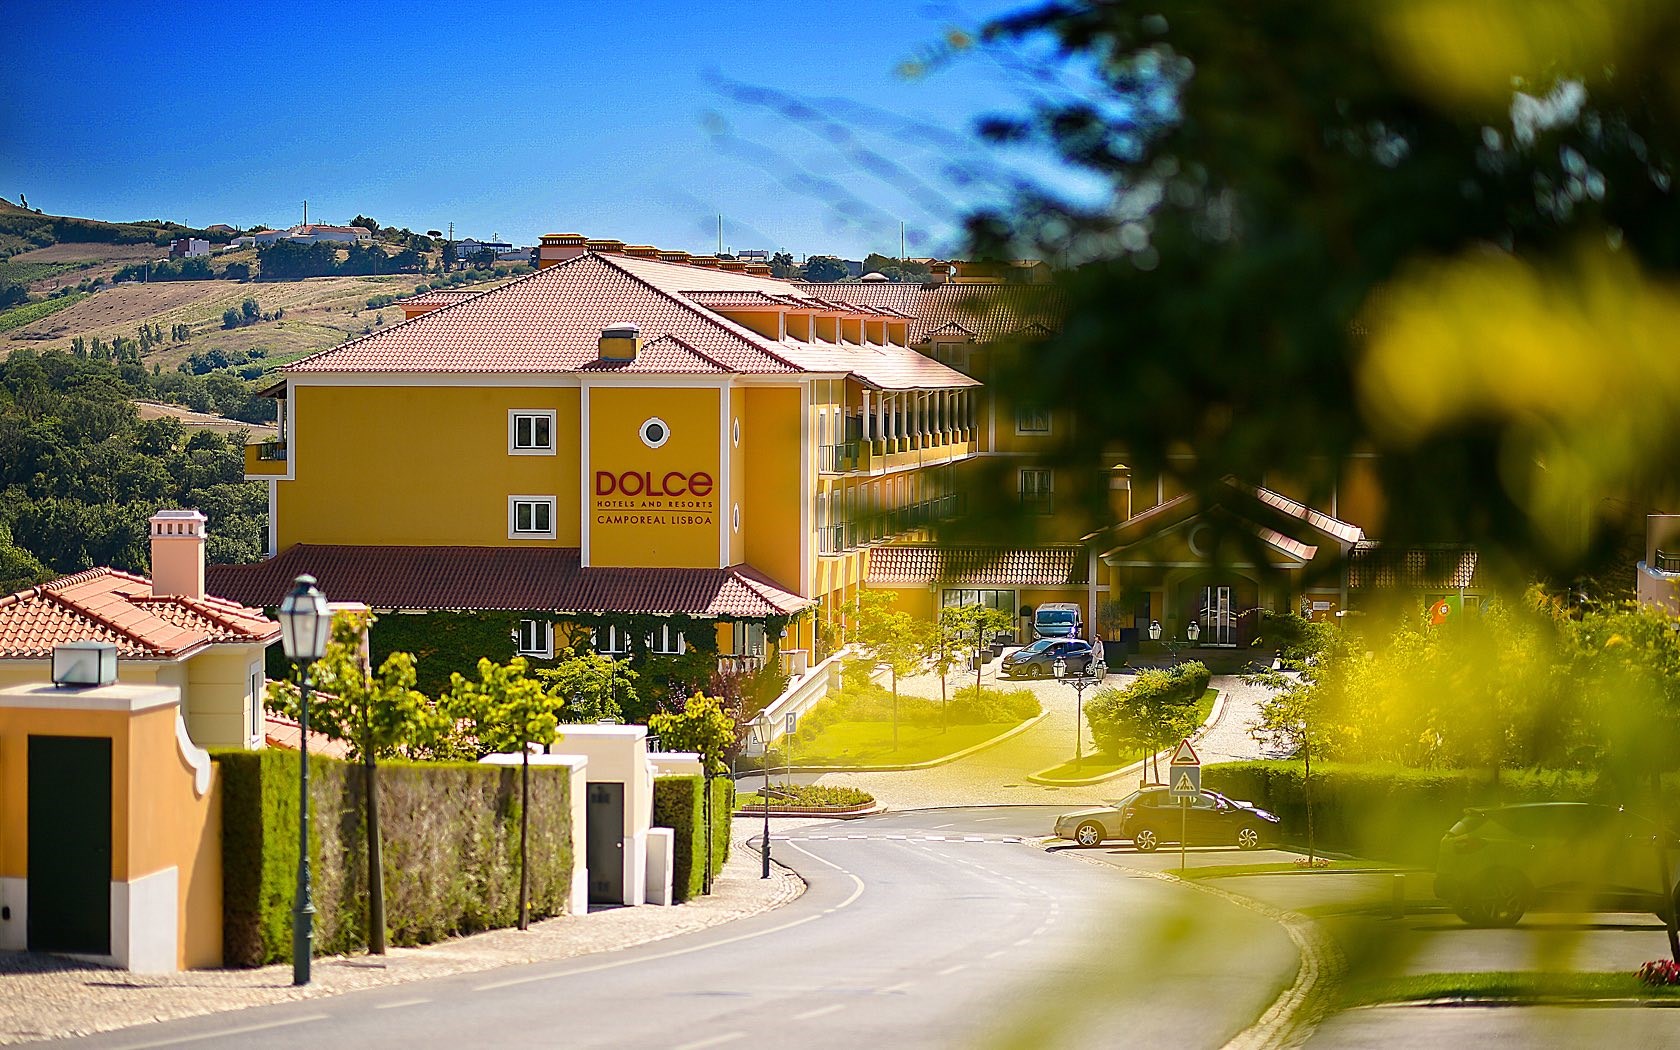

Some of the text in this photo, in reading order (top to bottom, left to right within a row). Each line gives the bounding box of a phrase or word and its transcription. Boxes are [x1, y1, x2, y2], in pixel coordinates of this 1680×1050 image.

[597, 515, 712, 525] CAMPOREAL LISBOA
[787, 715, 794, 731] P
